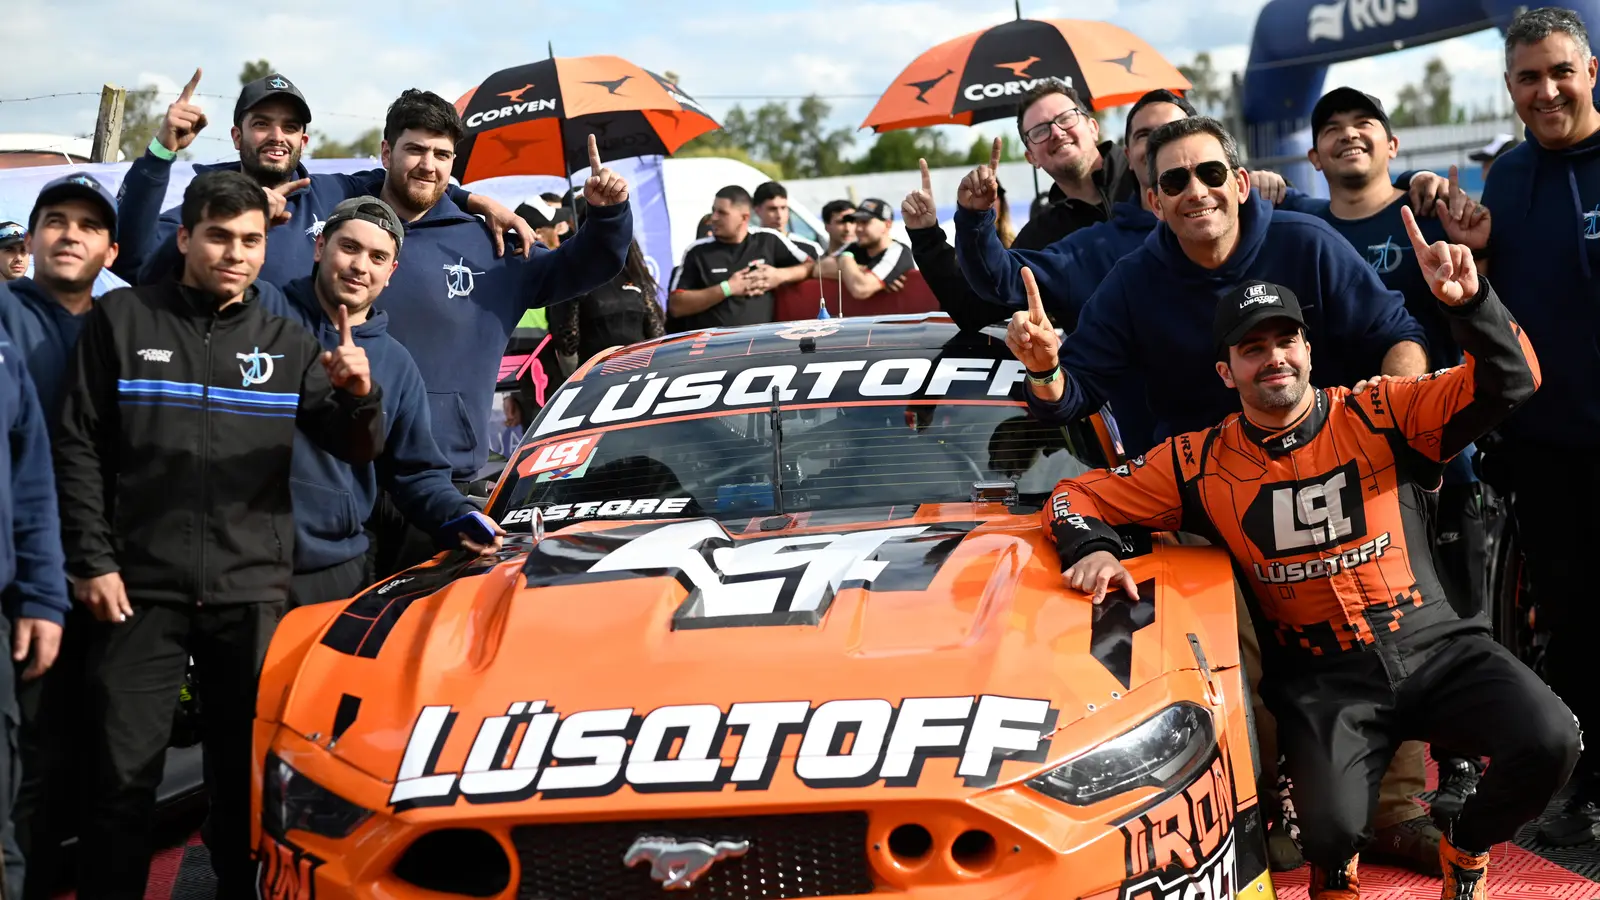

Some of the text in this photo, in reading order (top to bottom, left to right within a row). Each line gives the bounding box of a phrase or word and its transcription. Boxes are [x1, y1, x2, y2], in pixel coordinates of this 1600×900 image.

[466, 98, 557, 128] CORVEN
[1179, 436, 1195, 464] HRX
[1253, 532, 1390, 583] LÜSQTOFF
[389, 695, 1054, 804] LÜSQTOFF
[1124, 757, 1234, 875] IRON
